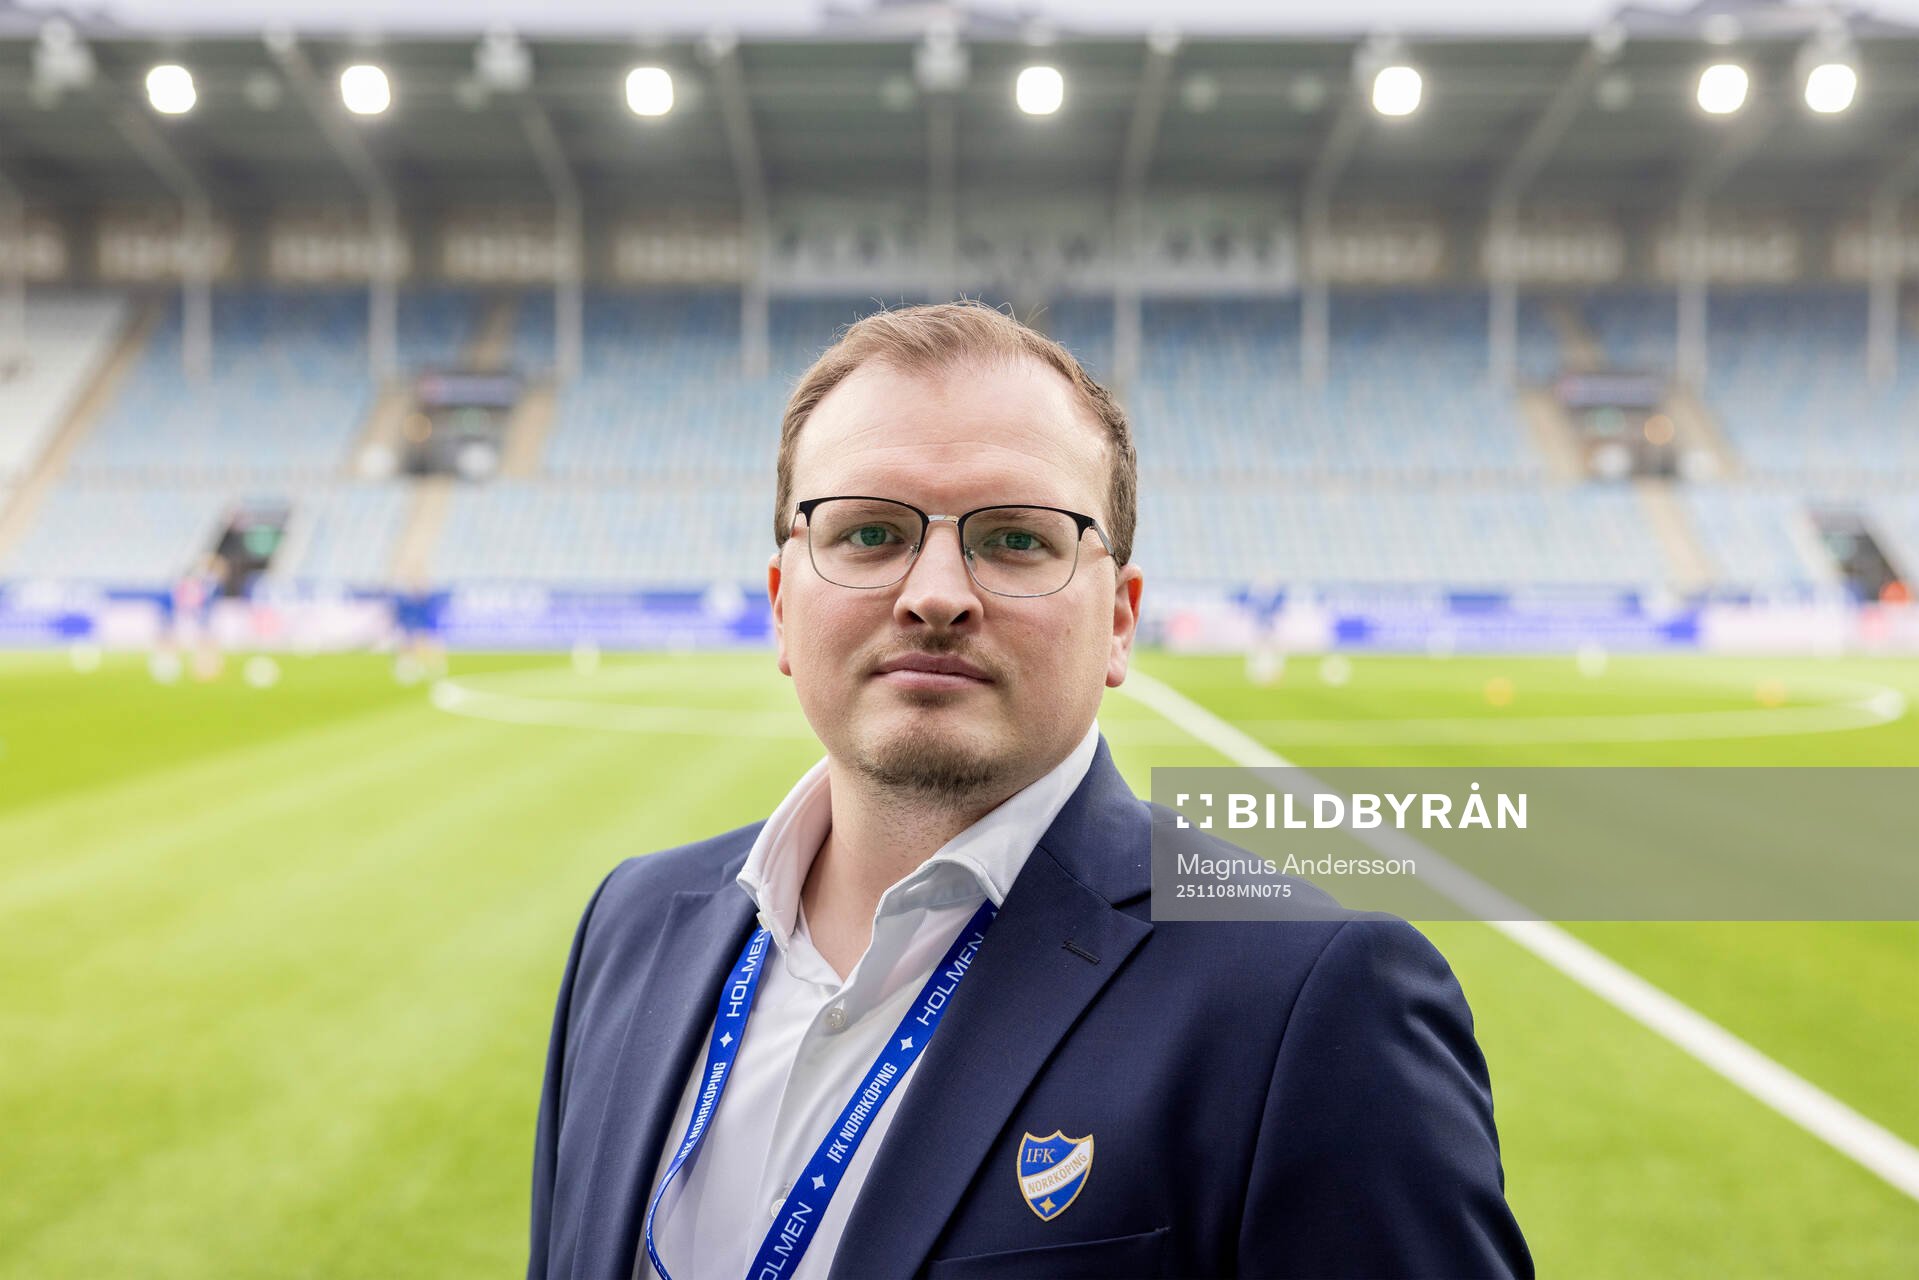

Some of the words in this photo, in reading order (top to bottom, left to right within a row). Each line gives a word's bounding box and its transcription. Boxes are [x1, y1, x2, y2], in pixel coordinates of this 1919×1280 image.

[726, 929, 767, 1017] HOLMEN
[916, 932, 985, 1026] HOLMEN
[688, 1061, 727, 1140] NORRKÖPING
[826, 1138, 849, 1164] IFK
[839, 1062, 898, 1142] NORRKÖPING
[1025, 1147, 1057, 1164] IFK
[758, 1201, 813, 1280] OLMEN
